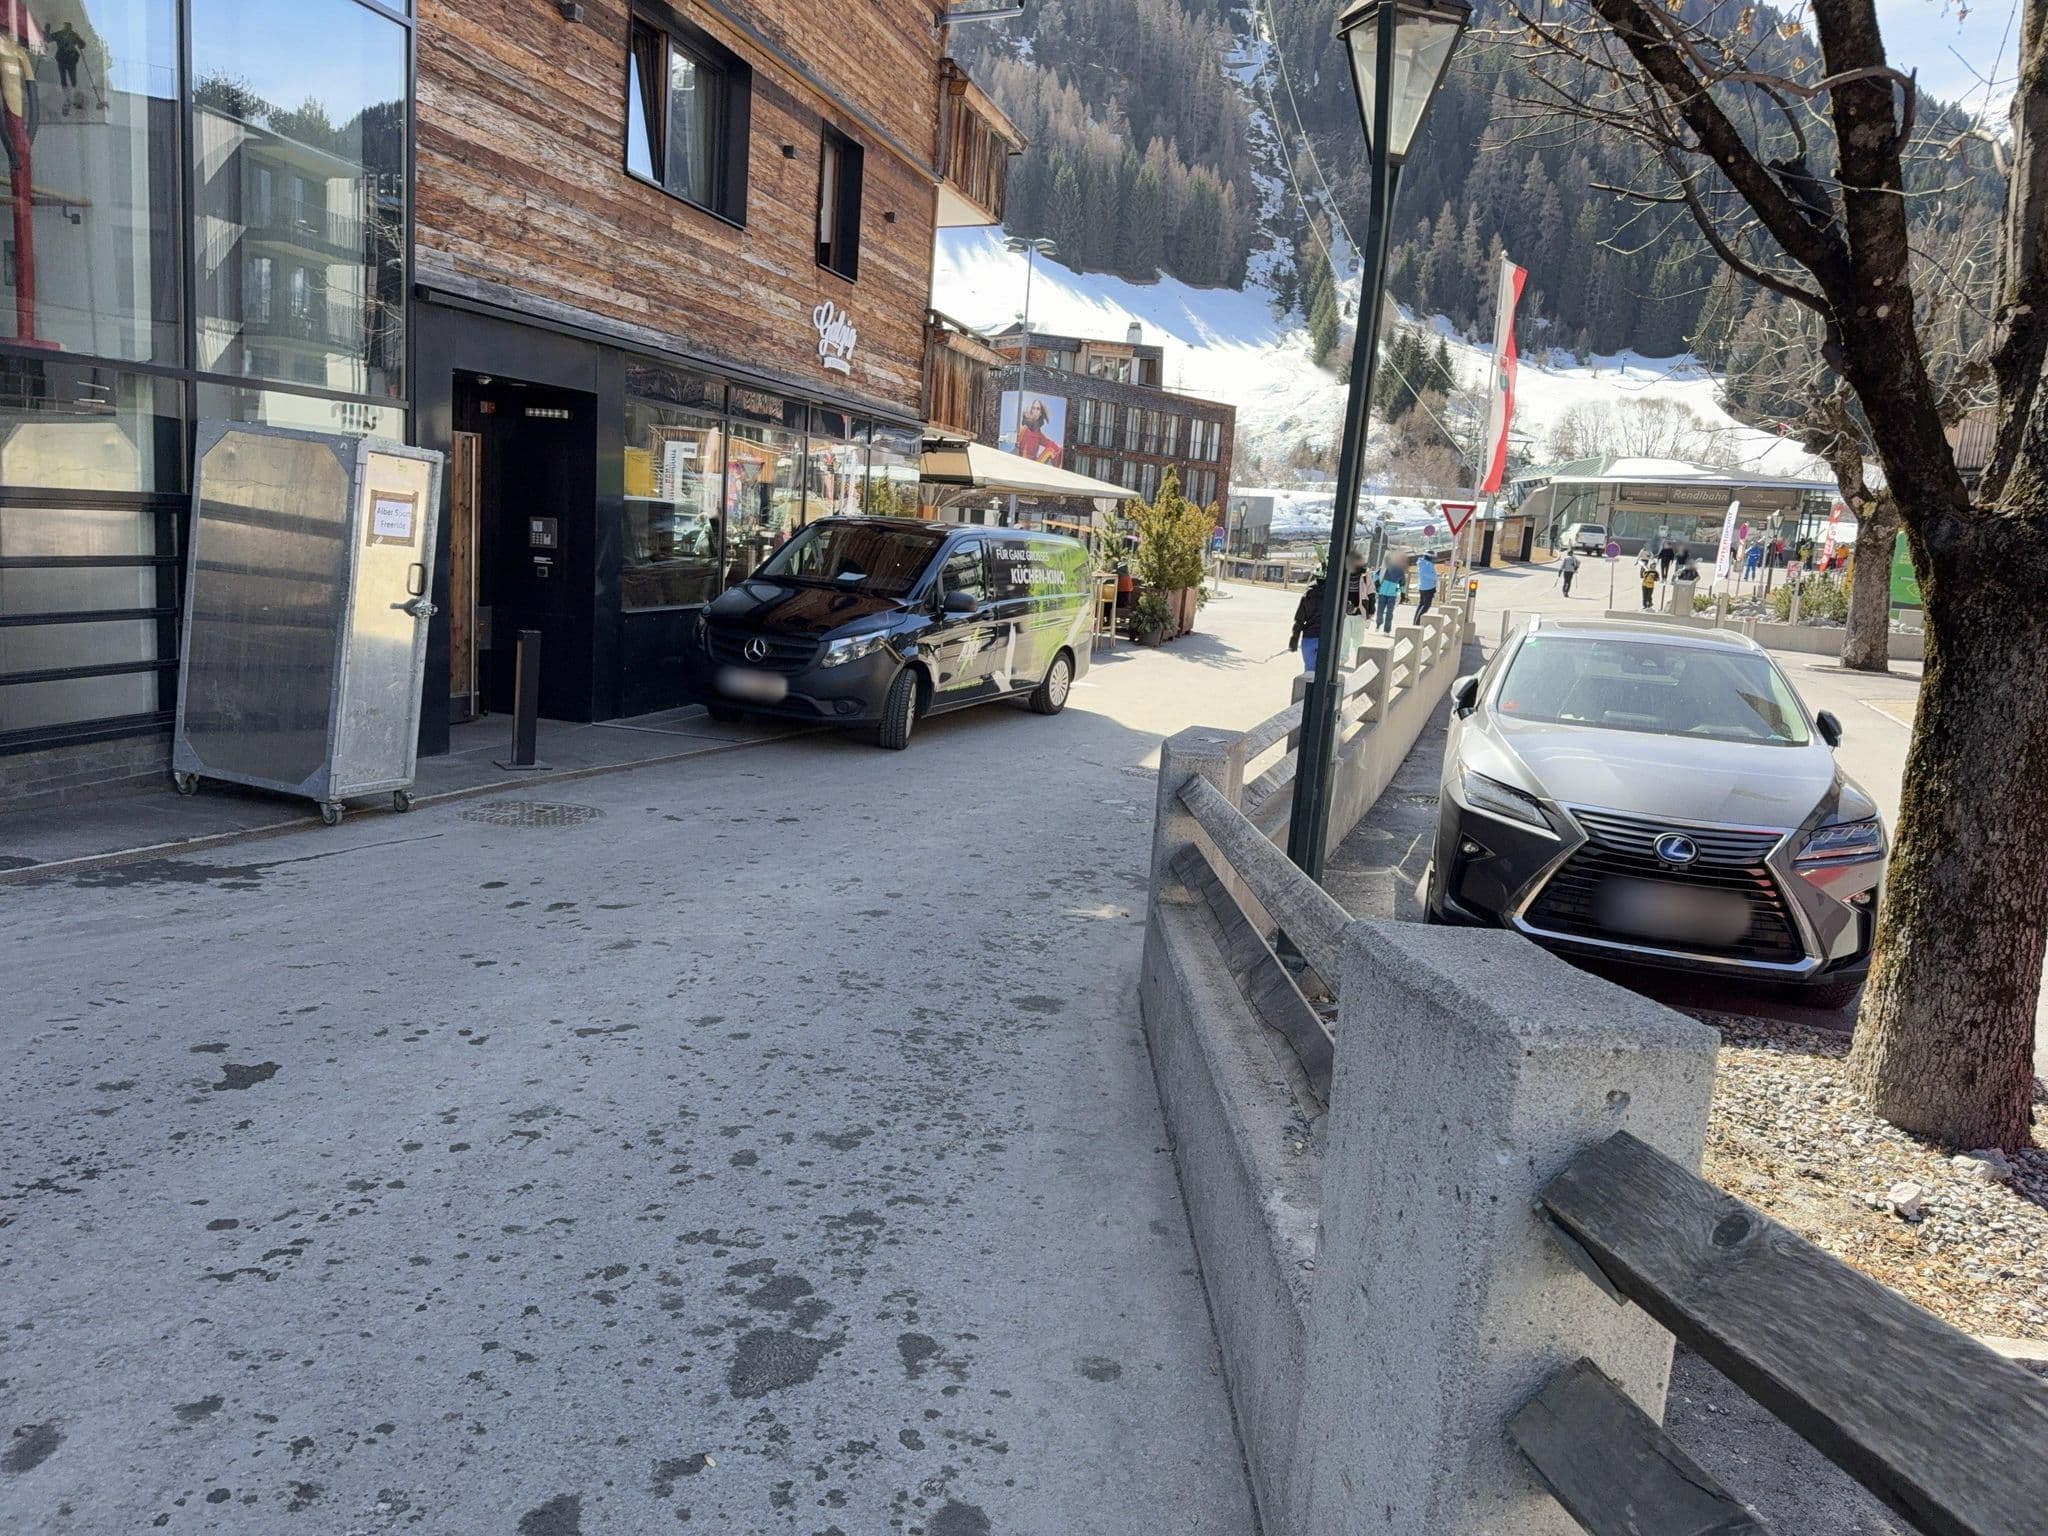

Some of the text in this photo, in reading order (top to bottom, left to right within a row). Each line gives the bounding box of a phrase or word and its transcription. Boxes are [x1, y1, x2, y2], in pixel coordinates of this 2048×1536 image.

[1673, 489, 1728, 503] Rendlbahn
[996, 546, 1050, 562] FÜR GANZ GROSSES
